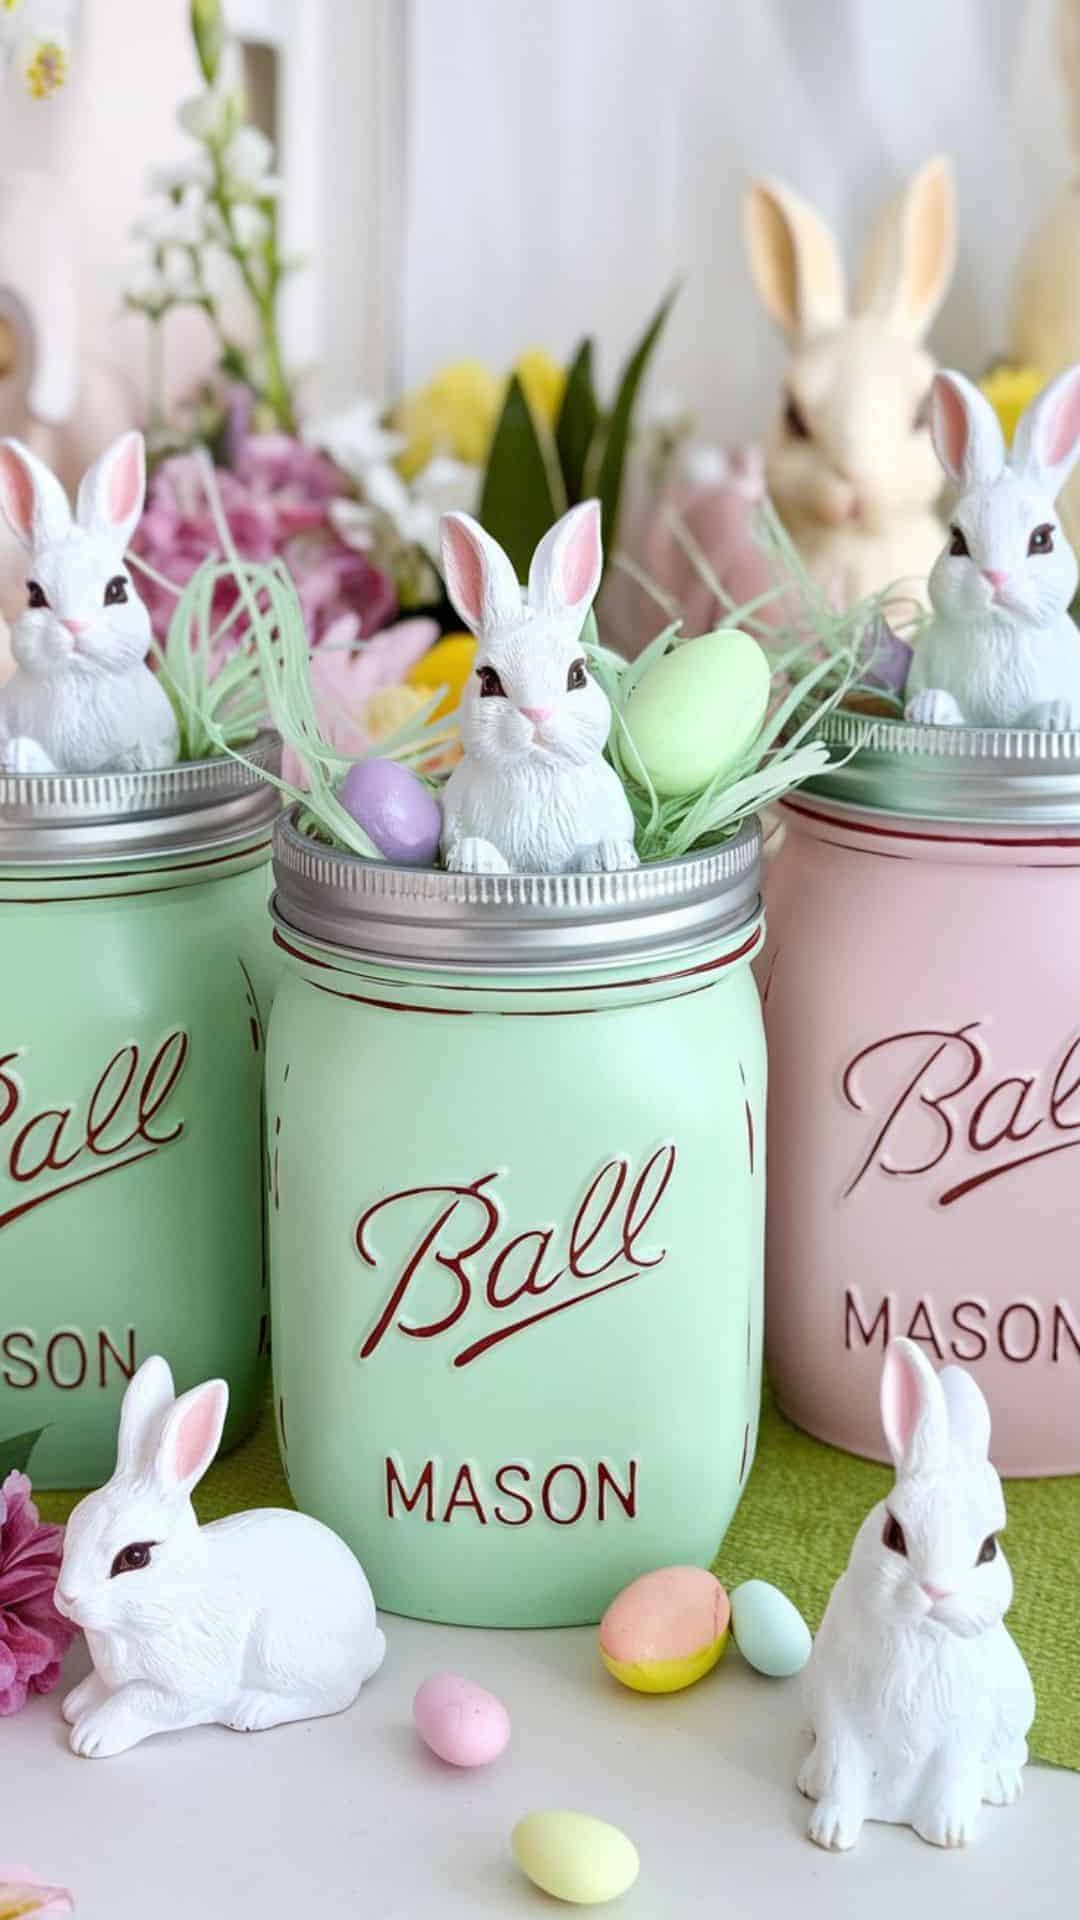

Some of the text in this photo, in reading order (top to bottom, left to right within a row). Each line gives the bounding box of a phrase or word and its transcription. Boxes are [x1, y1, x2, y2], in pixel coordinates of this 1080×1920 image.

[0, 1031, 188, 1182] all
[356, 1145, 676, 1360] Ball
[2, 1328, 136, 1389] SON
[844, 1290, 1080, 1364] MASON
[385, 1456, 637, 1526] MASON
